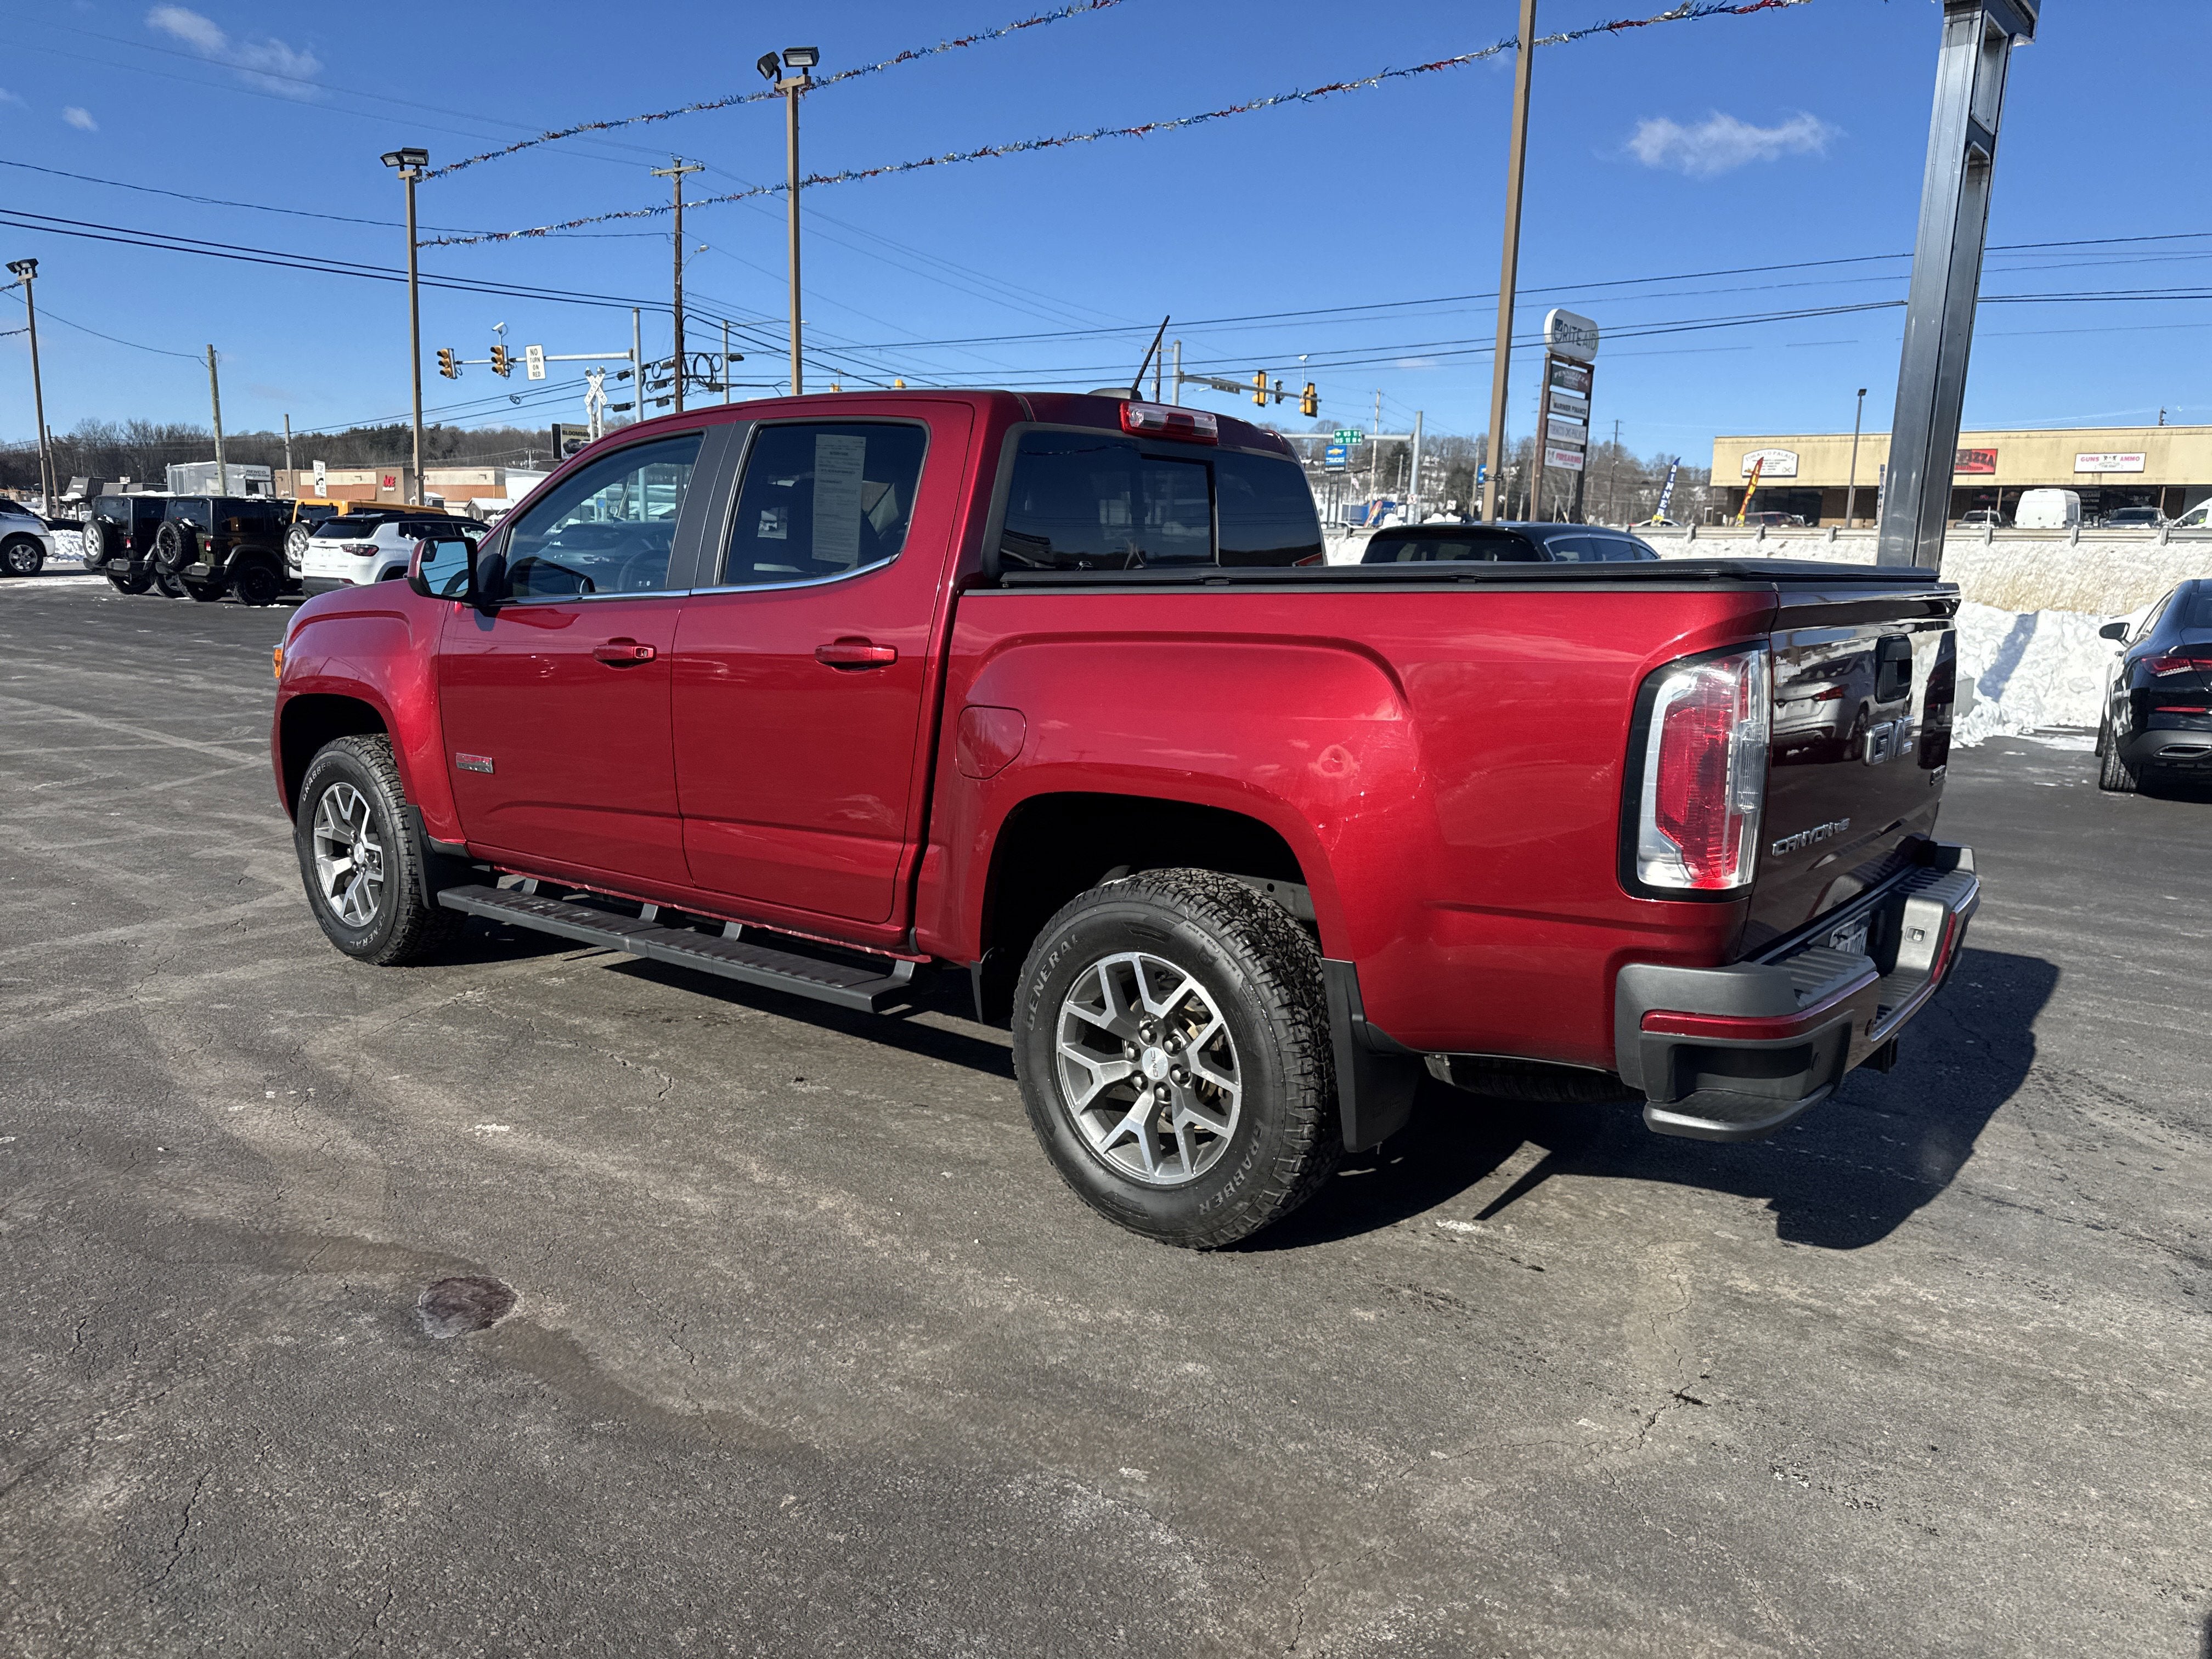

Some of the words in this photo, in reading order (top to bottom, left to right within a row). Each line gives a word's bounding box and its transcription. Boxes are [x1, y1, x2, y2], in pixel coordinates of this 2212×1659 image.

[1563, 324, 1582, 347] RITE
[1582, 331, 1597, 351] AID
[1773, 451, 1796, 461] PALACE
[383, 475, 396, 487] ACE
[1657, 464, 1677, 516] DINNER
[1150, 1050, 1159, 1077] GMC
